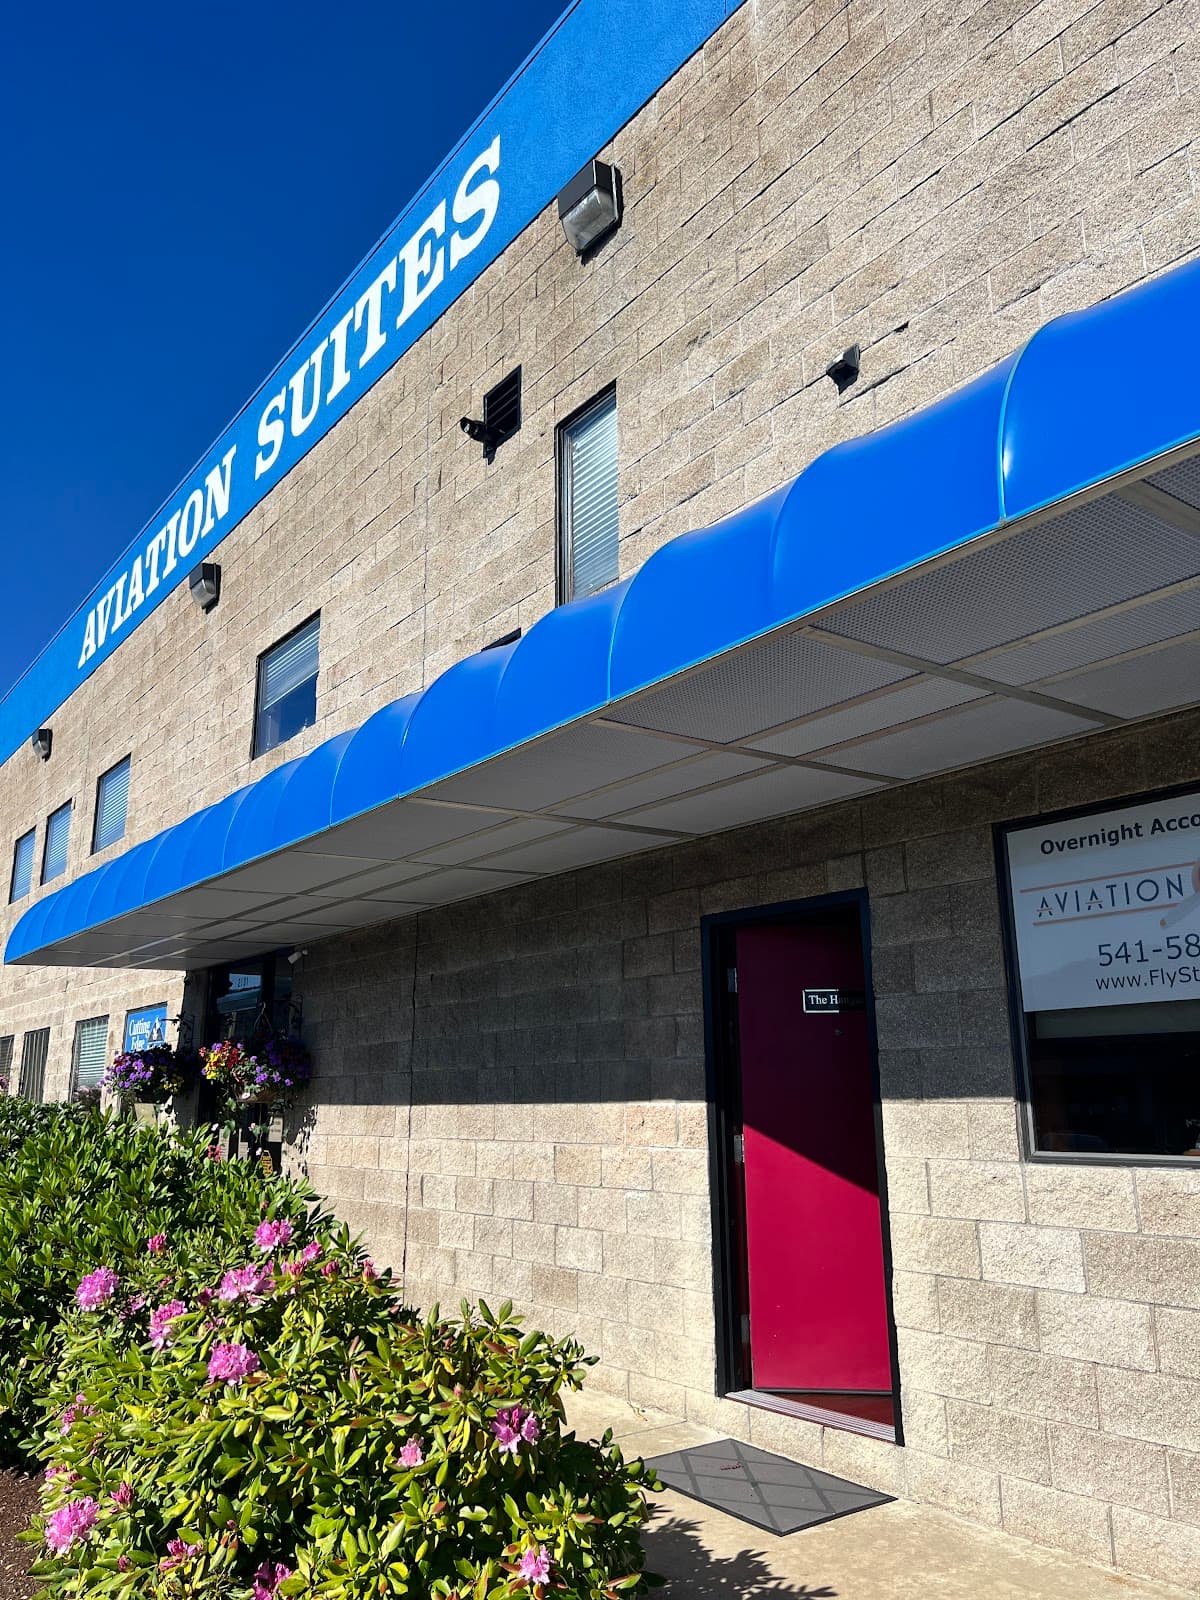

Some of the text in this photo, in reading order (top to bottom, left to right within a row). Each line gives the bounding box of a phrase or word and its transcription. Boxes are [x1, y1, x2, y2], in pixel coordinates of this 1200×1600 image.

[77, 134, 502, 669] AVIATION SUITES
[1040, 813, 1200, 855] Overnight Acco
[1037, 873, 1184, 918] AVIATION
[1098, 933, 1200, 967] 541-58
[1096, 966, 1200, 990] www.FlySt
[808, 994, 827, 1005] The
[129, 1017, 151, 1038] Cutting
